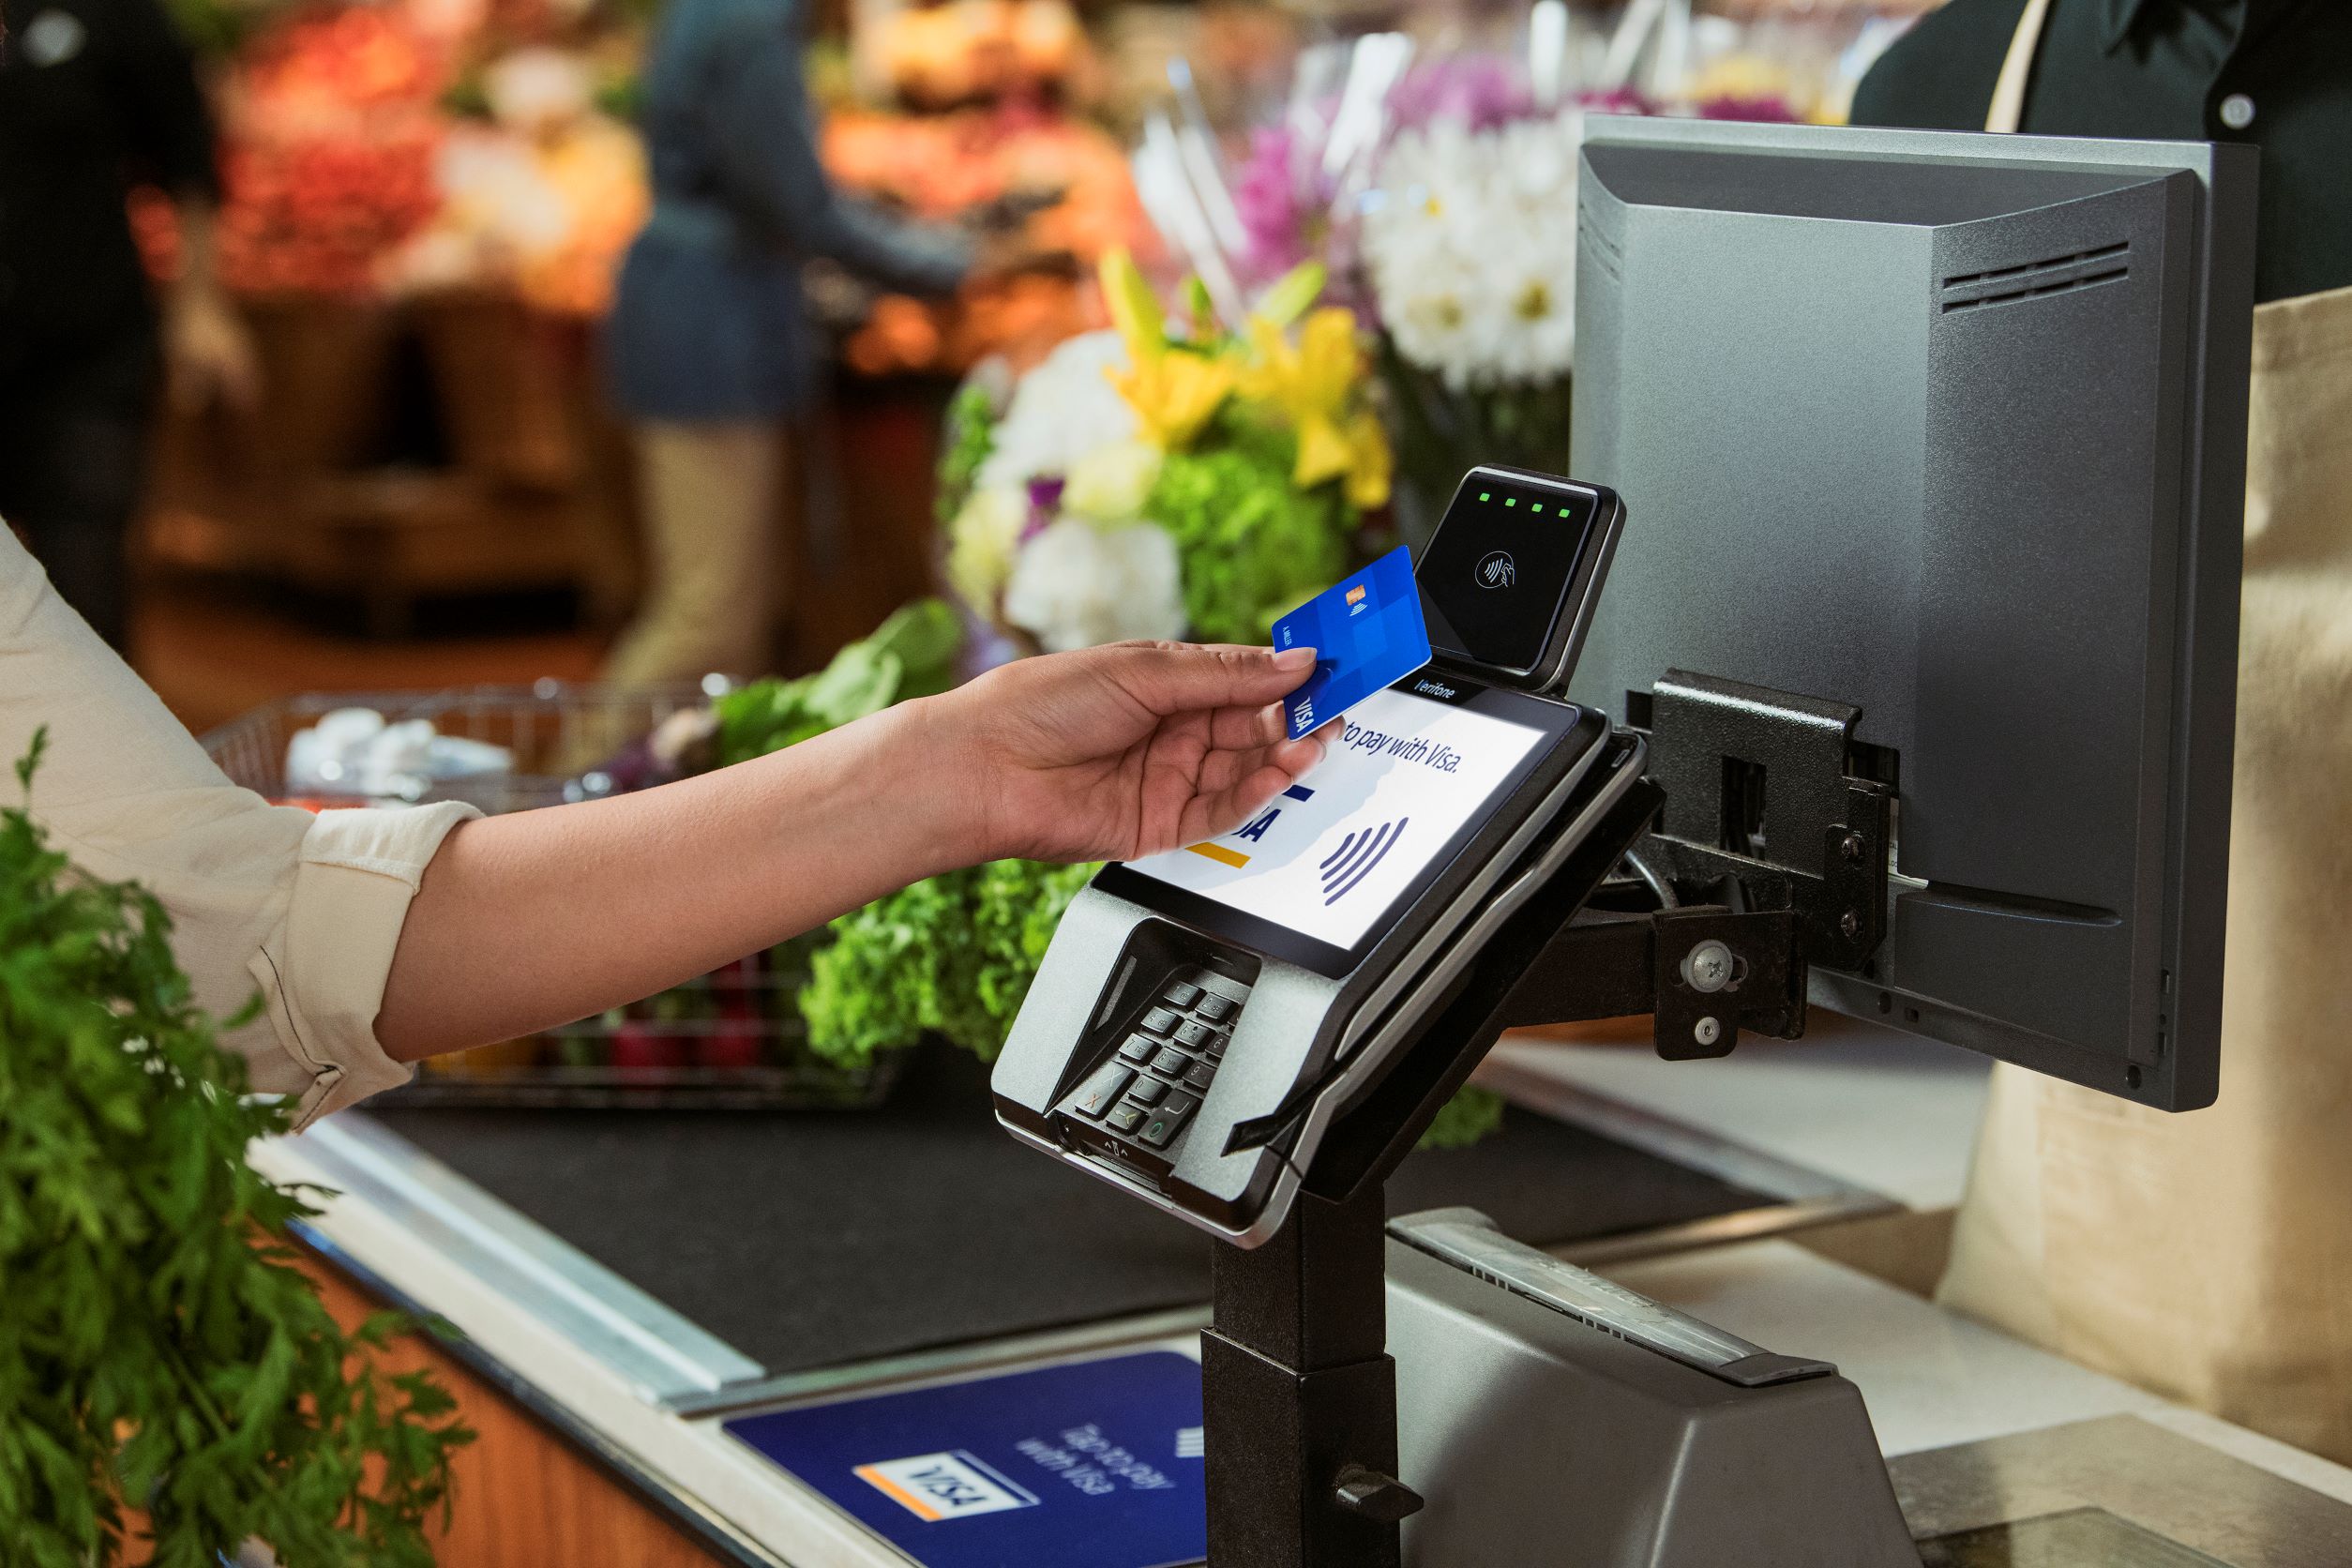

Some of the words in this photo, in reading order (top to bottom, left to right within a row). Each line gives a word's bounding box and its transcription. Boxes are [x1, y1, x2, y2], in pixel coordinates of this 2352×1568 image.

[1414, 679, 1455, 699] Verifone
[1294, 696, 1314, 732] VISA
[1344, 721, 1362, 743] to
[1350, 730, 1393, 756] pay
[1388, 737, 1429, 762] with
[1425, 743, 1461, 774] Visa.
[1190, 1065, 1200, 1076] 9
[908, 1465, 988, 1505] VISA
